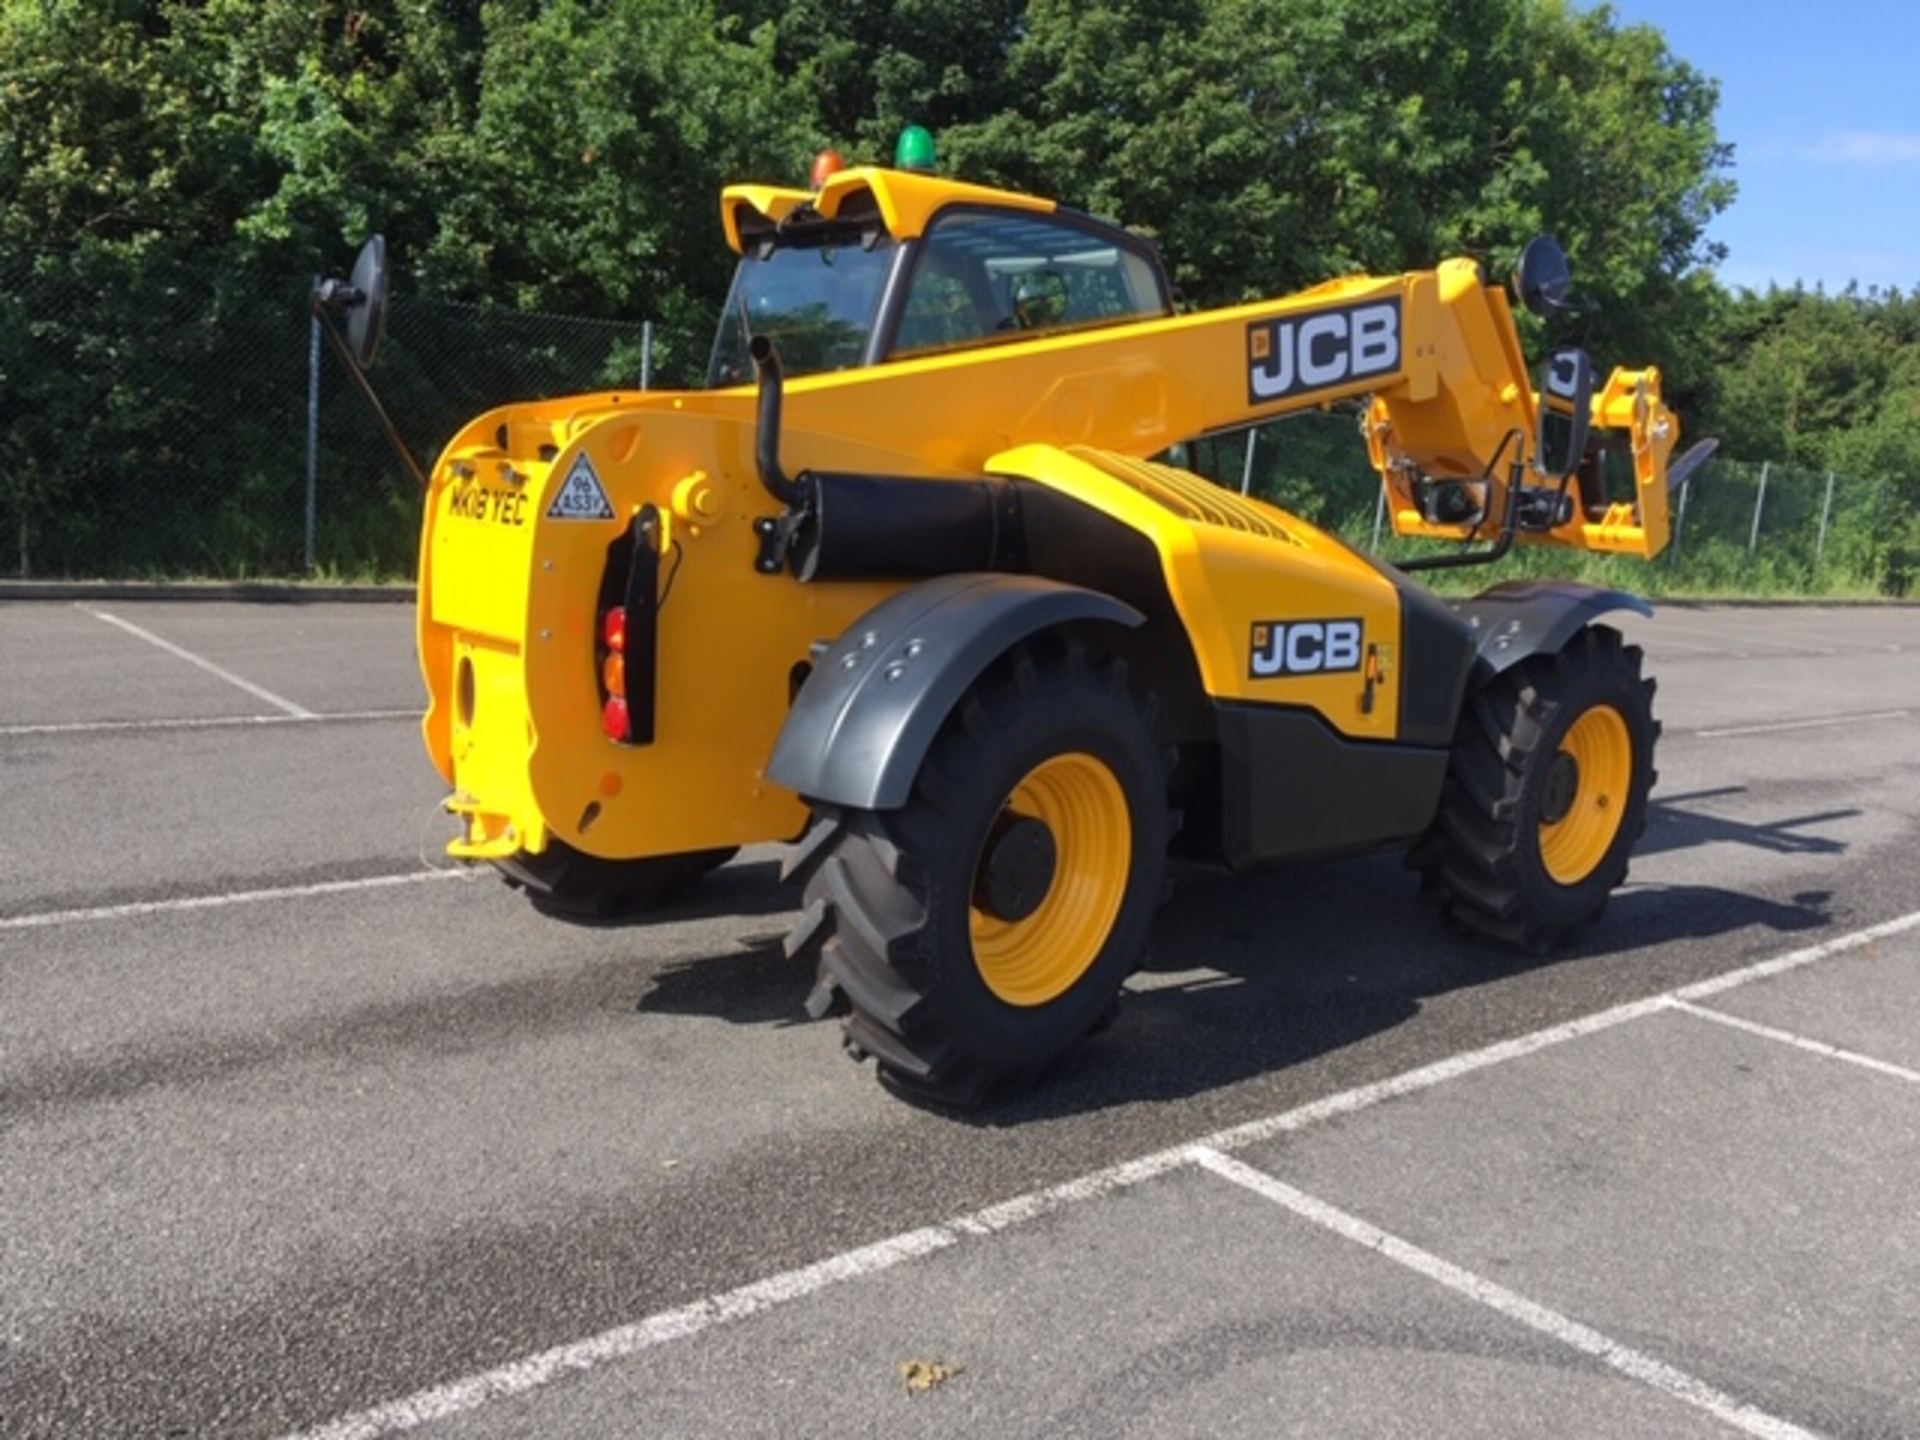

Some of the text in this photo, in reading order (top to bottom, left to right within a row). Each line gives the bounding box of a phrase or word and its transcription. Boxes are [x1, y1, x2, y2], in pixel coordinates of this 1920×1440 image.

[1252, 304, 1398, 397] JCB
[491, 491, 528, 526] YEC
[1253, 622, 1361, 674] JCB
